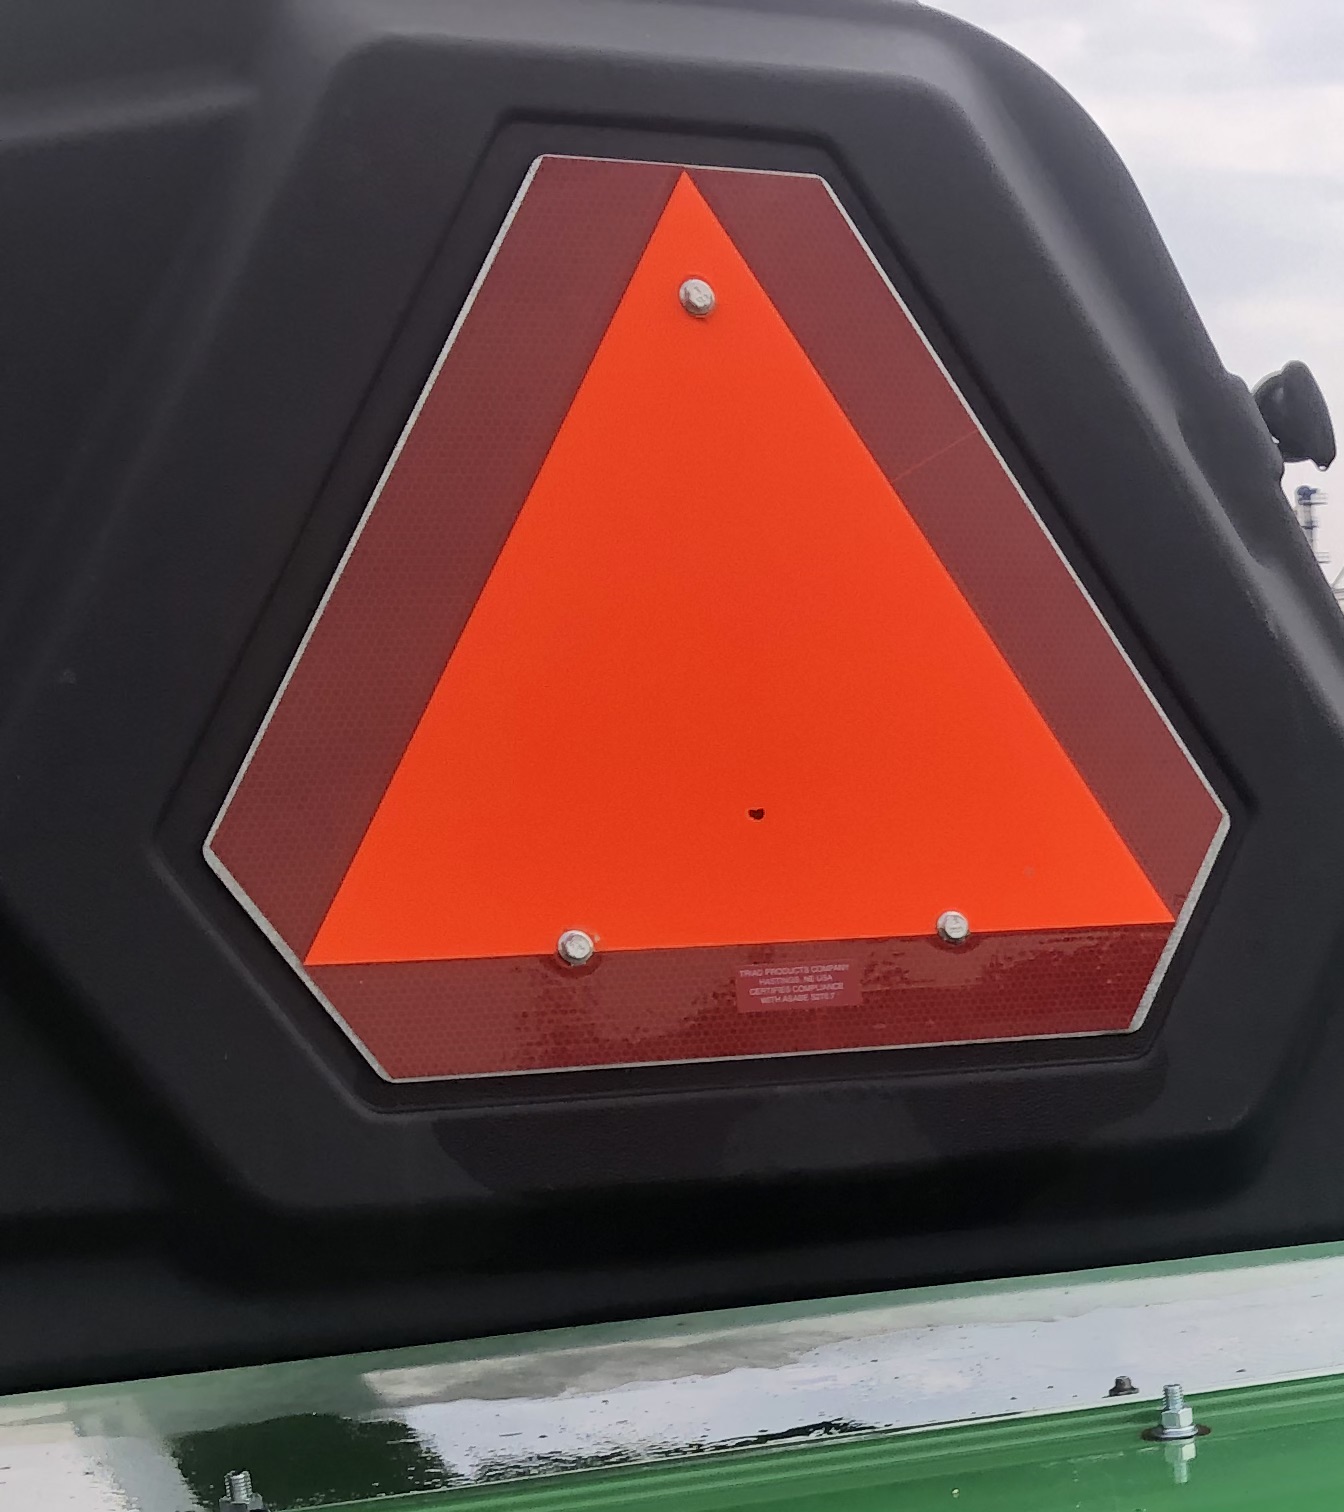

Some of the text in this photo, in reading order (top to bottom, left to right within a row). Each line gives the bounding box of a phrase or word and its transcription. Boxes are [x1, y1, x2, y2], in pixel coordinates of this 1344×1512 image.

[740, 964, 849, 977] TRIAD PRODUCTS COMPANY
[816, 974, 832, 982] USA
[749, 983, 844, 996] CERTIFIES COMPLIANCE
